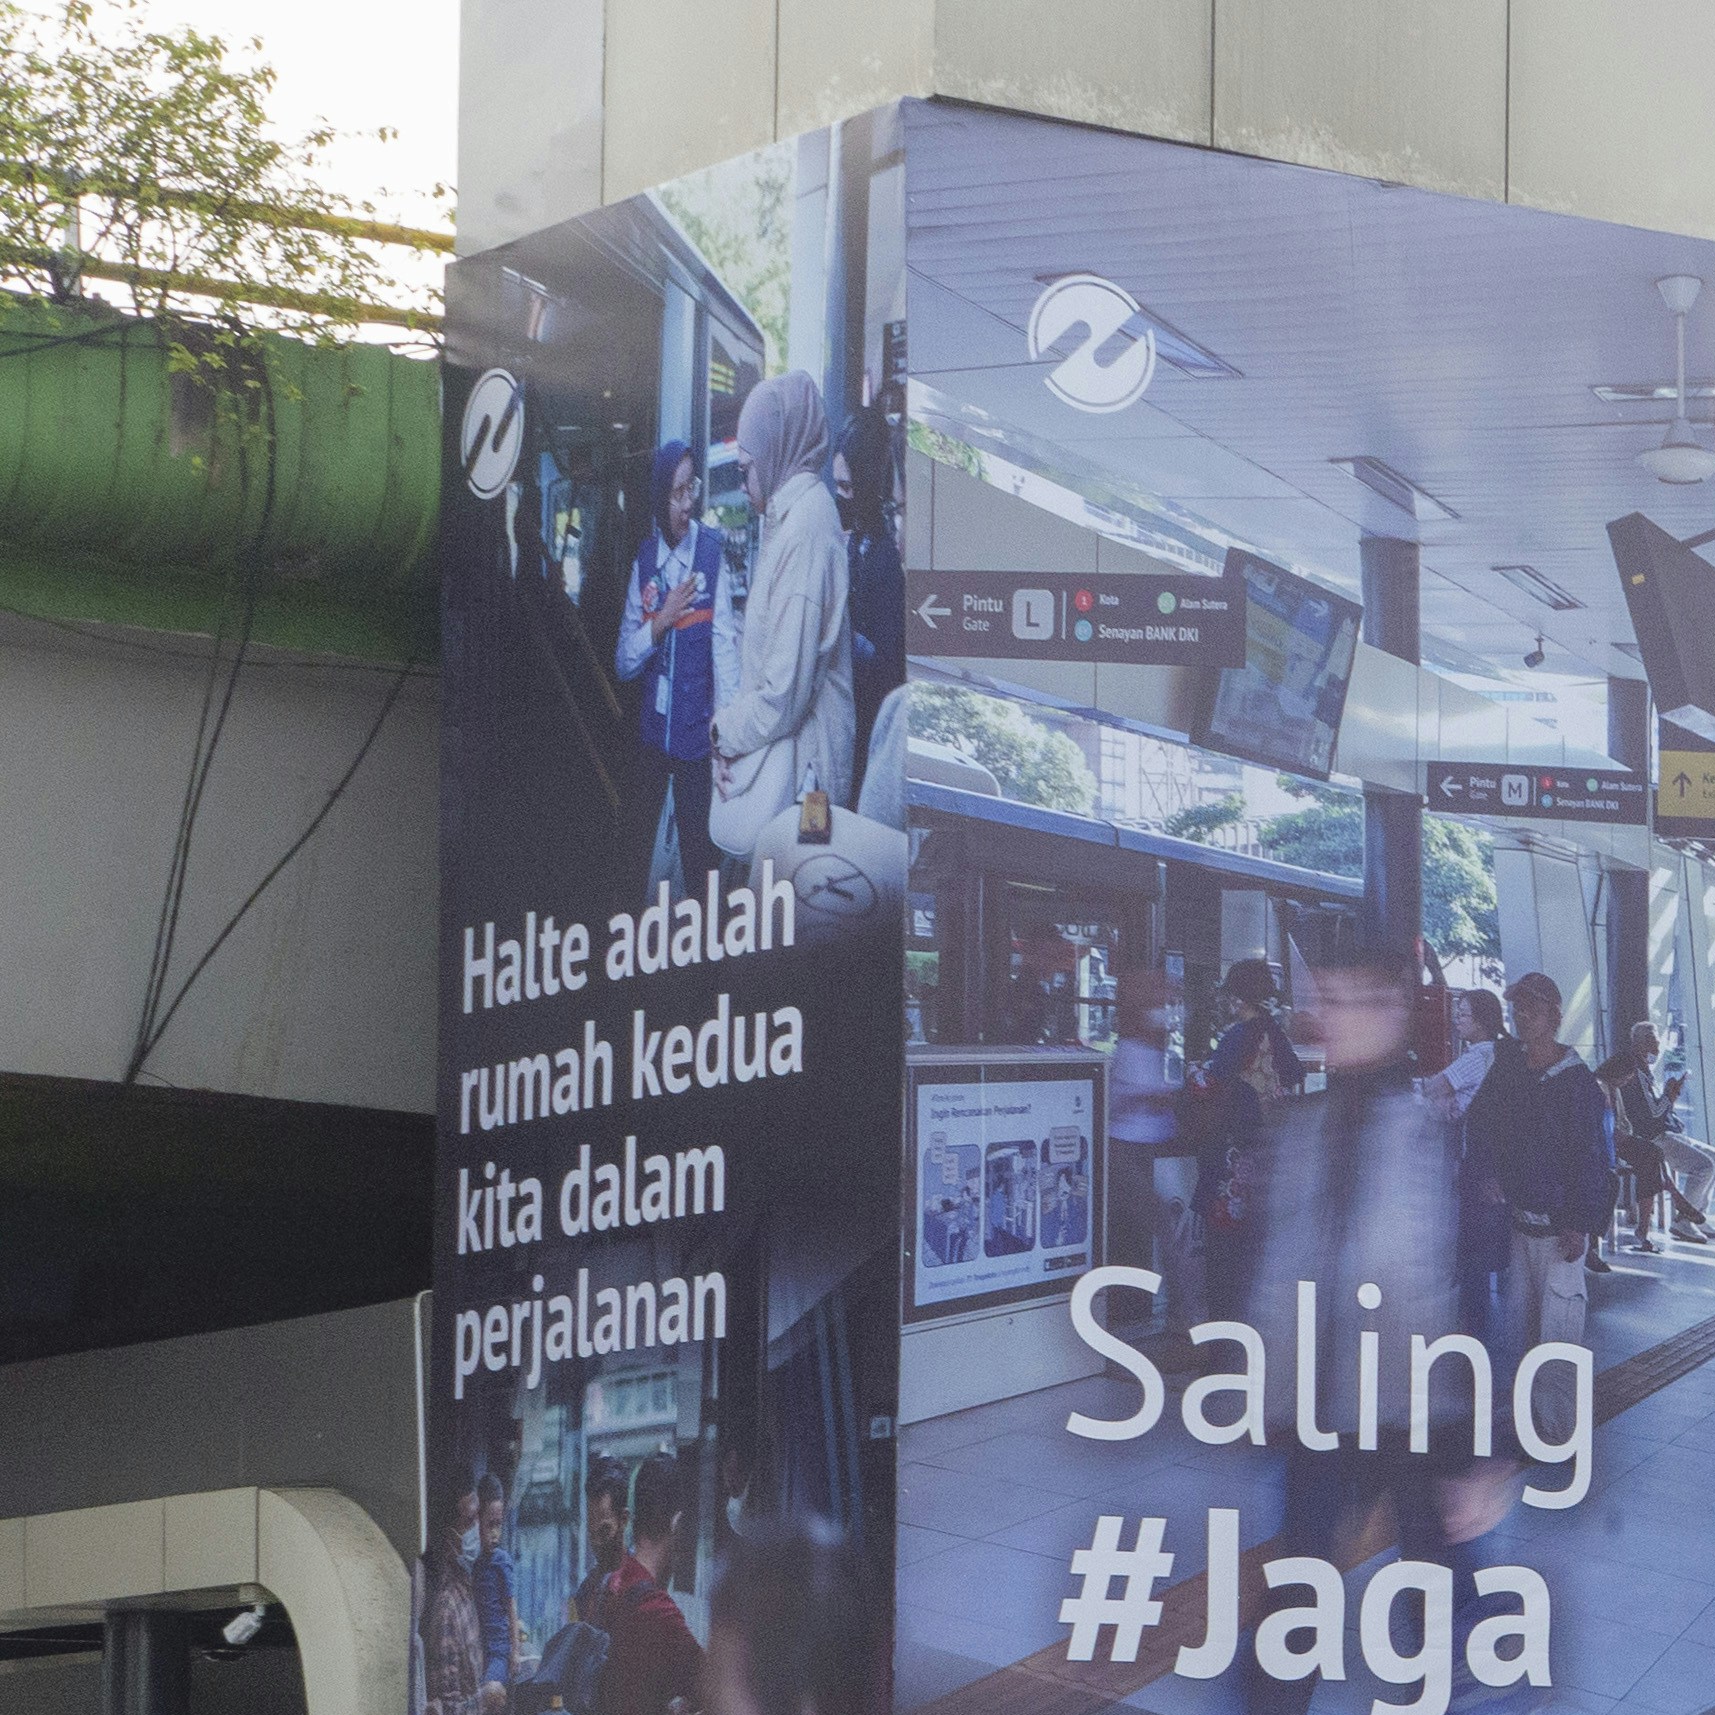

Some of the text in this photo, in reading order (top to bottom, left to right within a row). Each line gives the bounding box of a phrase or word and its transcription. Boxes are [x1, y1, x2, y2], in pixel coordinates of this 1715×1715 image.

[963, 594, 1041, 627] Pintu L
[963, 617, 990, 632] Gate
[1146, 626, 1178, 642] BANK
[462, 858, 796, 1014] Halte adalah
[458, 992, 804, 1136] rumah kedua
[457, 1134, 726, 1255] kita dalam
[454, 1268, 728, 1400] perjalanan
[1065, 1265, 1595, 1510] Saling
